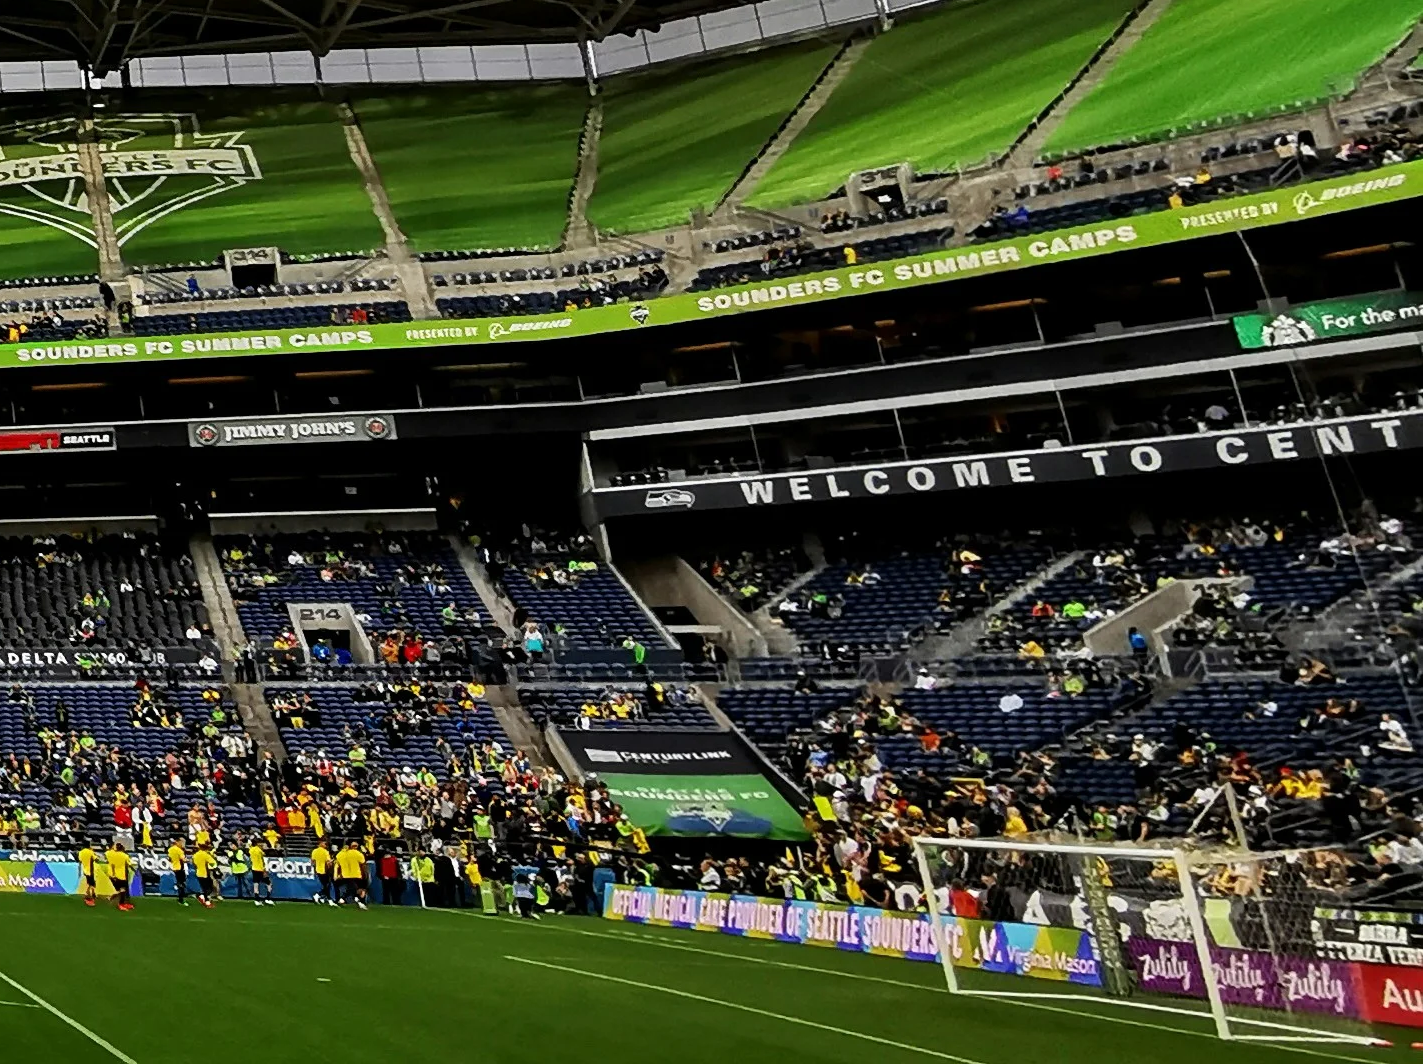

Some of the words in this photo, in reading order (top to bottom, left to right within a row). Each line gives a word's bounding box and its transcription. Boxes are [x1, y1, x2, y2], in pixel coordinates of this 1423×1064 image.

[187, 158, 237, 172] FC
[1320, 173, 1407, 202] BOEING
[697, 276, 841, 313] SOUNDERS
[850, 269, 885, 290] FC
[895, 247, 1020, 282] SUMMER
[1029, 225, 1137, 259] CAMPS
[509, 318, 572, 334] BOEING
[1321, 314, 1356, 330] For
[1360, 308, 1396, 325] the
[16, 342, 138, 363] SOUNDERS
[145, 339, 174, 357] FC
[180, 335, 282, 356] SUMMER
[290, 331, 374, 349] CAMPS
[63, 433, 110, 444] SEATTLE
[224, 424, 286, 441] JIMMY
[291, 421, 355, 438] JOHN'S
[739, 455, 1036, 509] WELCOME
[1089, 444, 1164, 478] TO
[1216, 420, 1401, 464] CENT
[300, 608, 341, 621] 214
[8, 652, 68, 665] DELTA
[620, 750, 732, 761] CENTURYLINK
[8, 873, 55, 889] Mason
[612, 888, 652, 919] OFFICIAL
[654, 893, 697, 925] MEDICAL
[700, 897, 727, 929] CARE
[729, 900, 784, 934] PROVIDER
[786, 905, 802, 937] OF
[807, 908, 860, 945] SEATTLE
[864, 914, 939, 955] SOUNDERS
[1006, 944, 1051, 971] Virginia
[1053, 950, 1096, 975] Mason
[1138, 946, 1191, 990] zulily
[1284, 963, 1346, 1013] zulily
